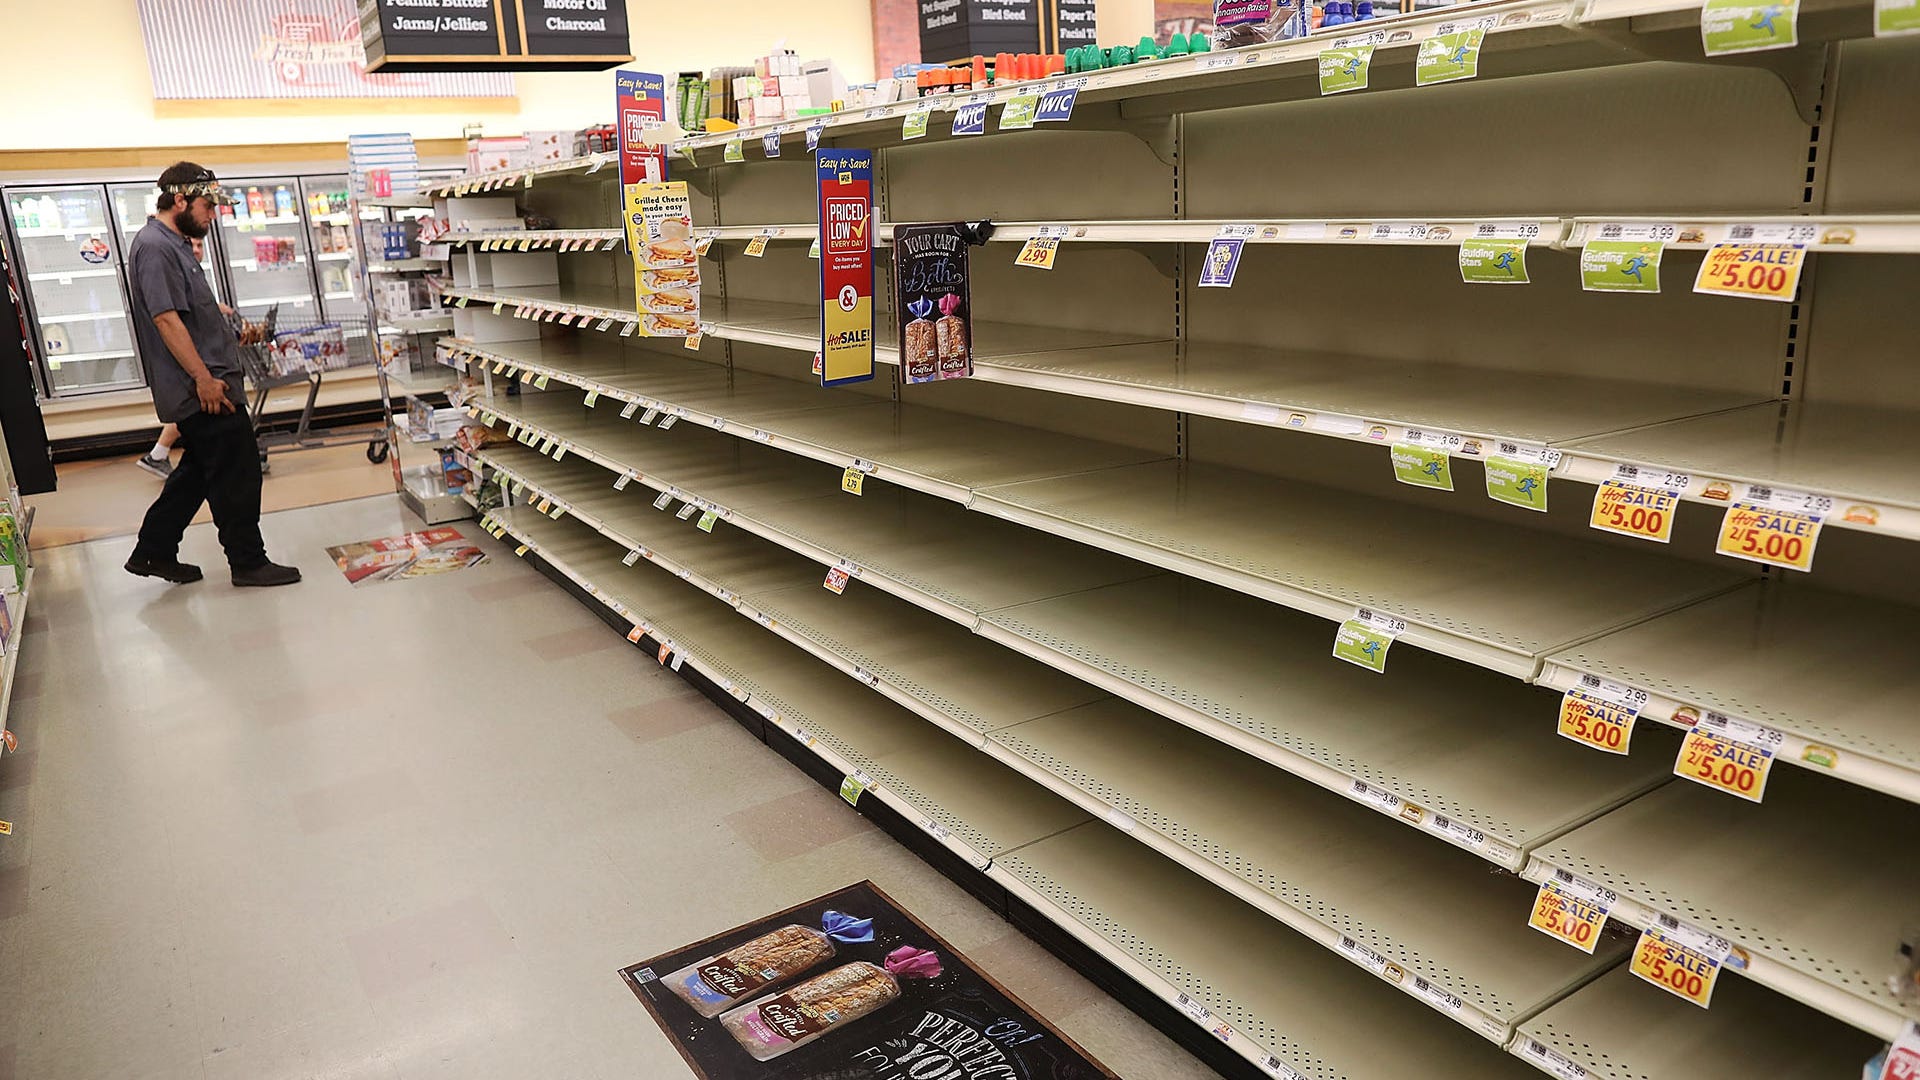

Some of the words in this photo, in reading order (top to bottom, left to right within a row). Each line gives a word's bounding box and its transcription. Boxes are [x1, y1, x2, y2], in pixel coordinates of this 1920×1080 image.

[544, 0, 585, 10] Motor
[586, 0, 607, 10] Oil
[1247, 4, 1269, 13] Raisin
[982, 9, 1001, 21] Bird
[1003, 9, 1026, 21] Seed
[1060, 10, 1085, 23] Paper
[393, 17, 488, 32] Jams/Jellies
[546, 17, 606, 31] Charcoal
[1060, 28, 1085, 39] Facial
[1367, 33, 1385, 45] 3.79
[618, 78, 633, 92] Easy
[635, 79, 643, 88] to
[1041, 94, 1073, 113] WIC
[957, 107, 985, 126] WIC
[806, 128, 821, 144] WIC
[764, 137, 779, 151] WIC
[820, 157, 838, 174] Easy
[840, 158, 848, 167] to
[849, 158, 870, 169] Save!
[634, 196, 660, 205] Grilled
[642, 204, 663, 212] made
[666, 204, 683, 212] easy
[829, 203, 864, 221] PRICED
[830, 222, 851, 240] LOW
[1408, 227, 1426, 238] 3.79
[1518, 226, 1539, 237] 3.99
[1649, 227, 1674, 239] 3.99
[1787, 227, 1815, 240] 2.99
[831, 240, 850, 248] EVERY
[851, 239, 864, 247] DAY
[904, 234, 932, 254] YOUR
[934, 233, 960, 252] CART
[1022, 249, 1048, 263] 2.99
[1461, 248, 1495, 260] Guiding
[1584, 252, 1623, 265] Guiding
[1461, 258, 1482, 267] Stars
[1584, 262, 1607, 272] Stars
[905, 257, 953, 292] Both
[1709, 263, 1786, 292] 2/5.00
[843, 290, 853, 307] &
[1393, 452, 1423, 467] Guiding
[1487, 467, 1517, 483] Guiding
[1664, 474, 1689, 488] 2.99
[1804, 496, 1832, 511] 2.99
[1600, 502, 1662, 534] 2/5.00
[1729, 526, 1802, 561] 2/5.00
[1388, 620, 1405, 631] 3.49
[1339, 627, 1367, 644] Guiding
[1624, 688, 1647, 704] 2.99
[1565, 712, 1622, 748] 2/5.00
[1757, 728, 1783, 745] 2.99
[1687, 752, 1754, 792] 2/5.00
[1382, 793, 1399, 806] 3.49
[1466, 829, 1484, 843] 3.49
[1595, 887, 1617, 903] 2.99
[1538, 904, 1591, 943] 2/5.00
[1705, 934, 1729, 953] 2.99
[1370, 951, 1385, 965] 3.49
[704, 966, 748, 994] Crafted
[1640, 952, 1702, 997] 2/5.00
[1445, 994, 1462, 1009] 3.49
[765, 1004, 808, 1037] Crafted
[984, 1016, 1047, 1048] Oh!
[908, 1010, 1018, 1080] PERFEC
[1566, 1060, 1586, 1077] 2.99
